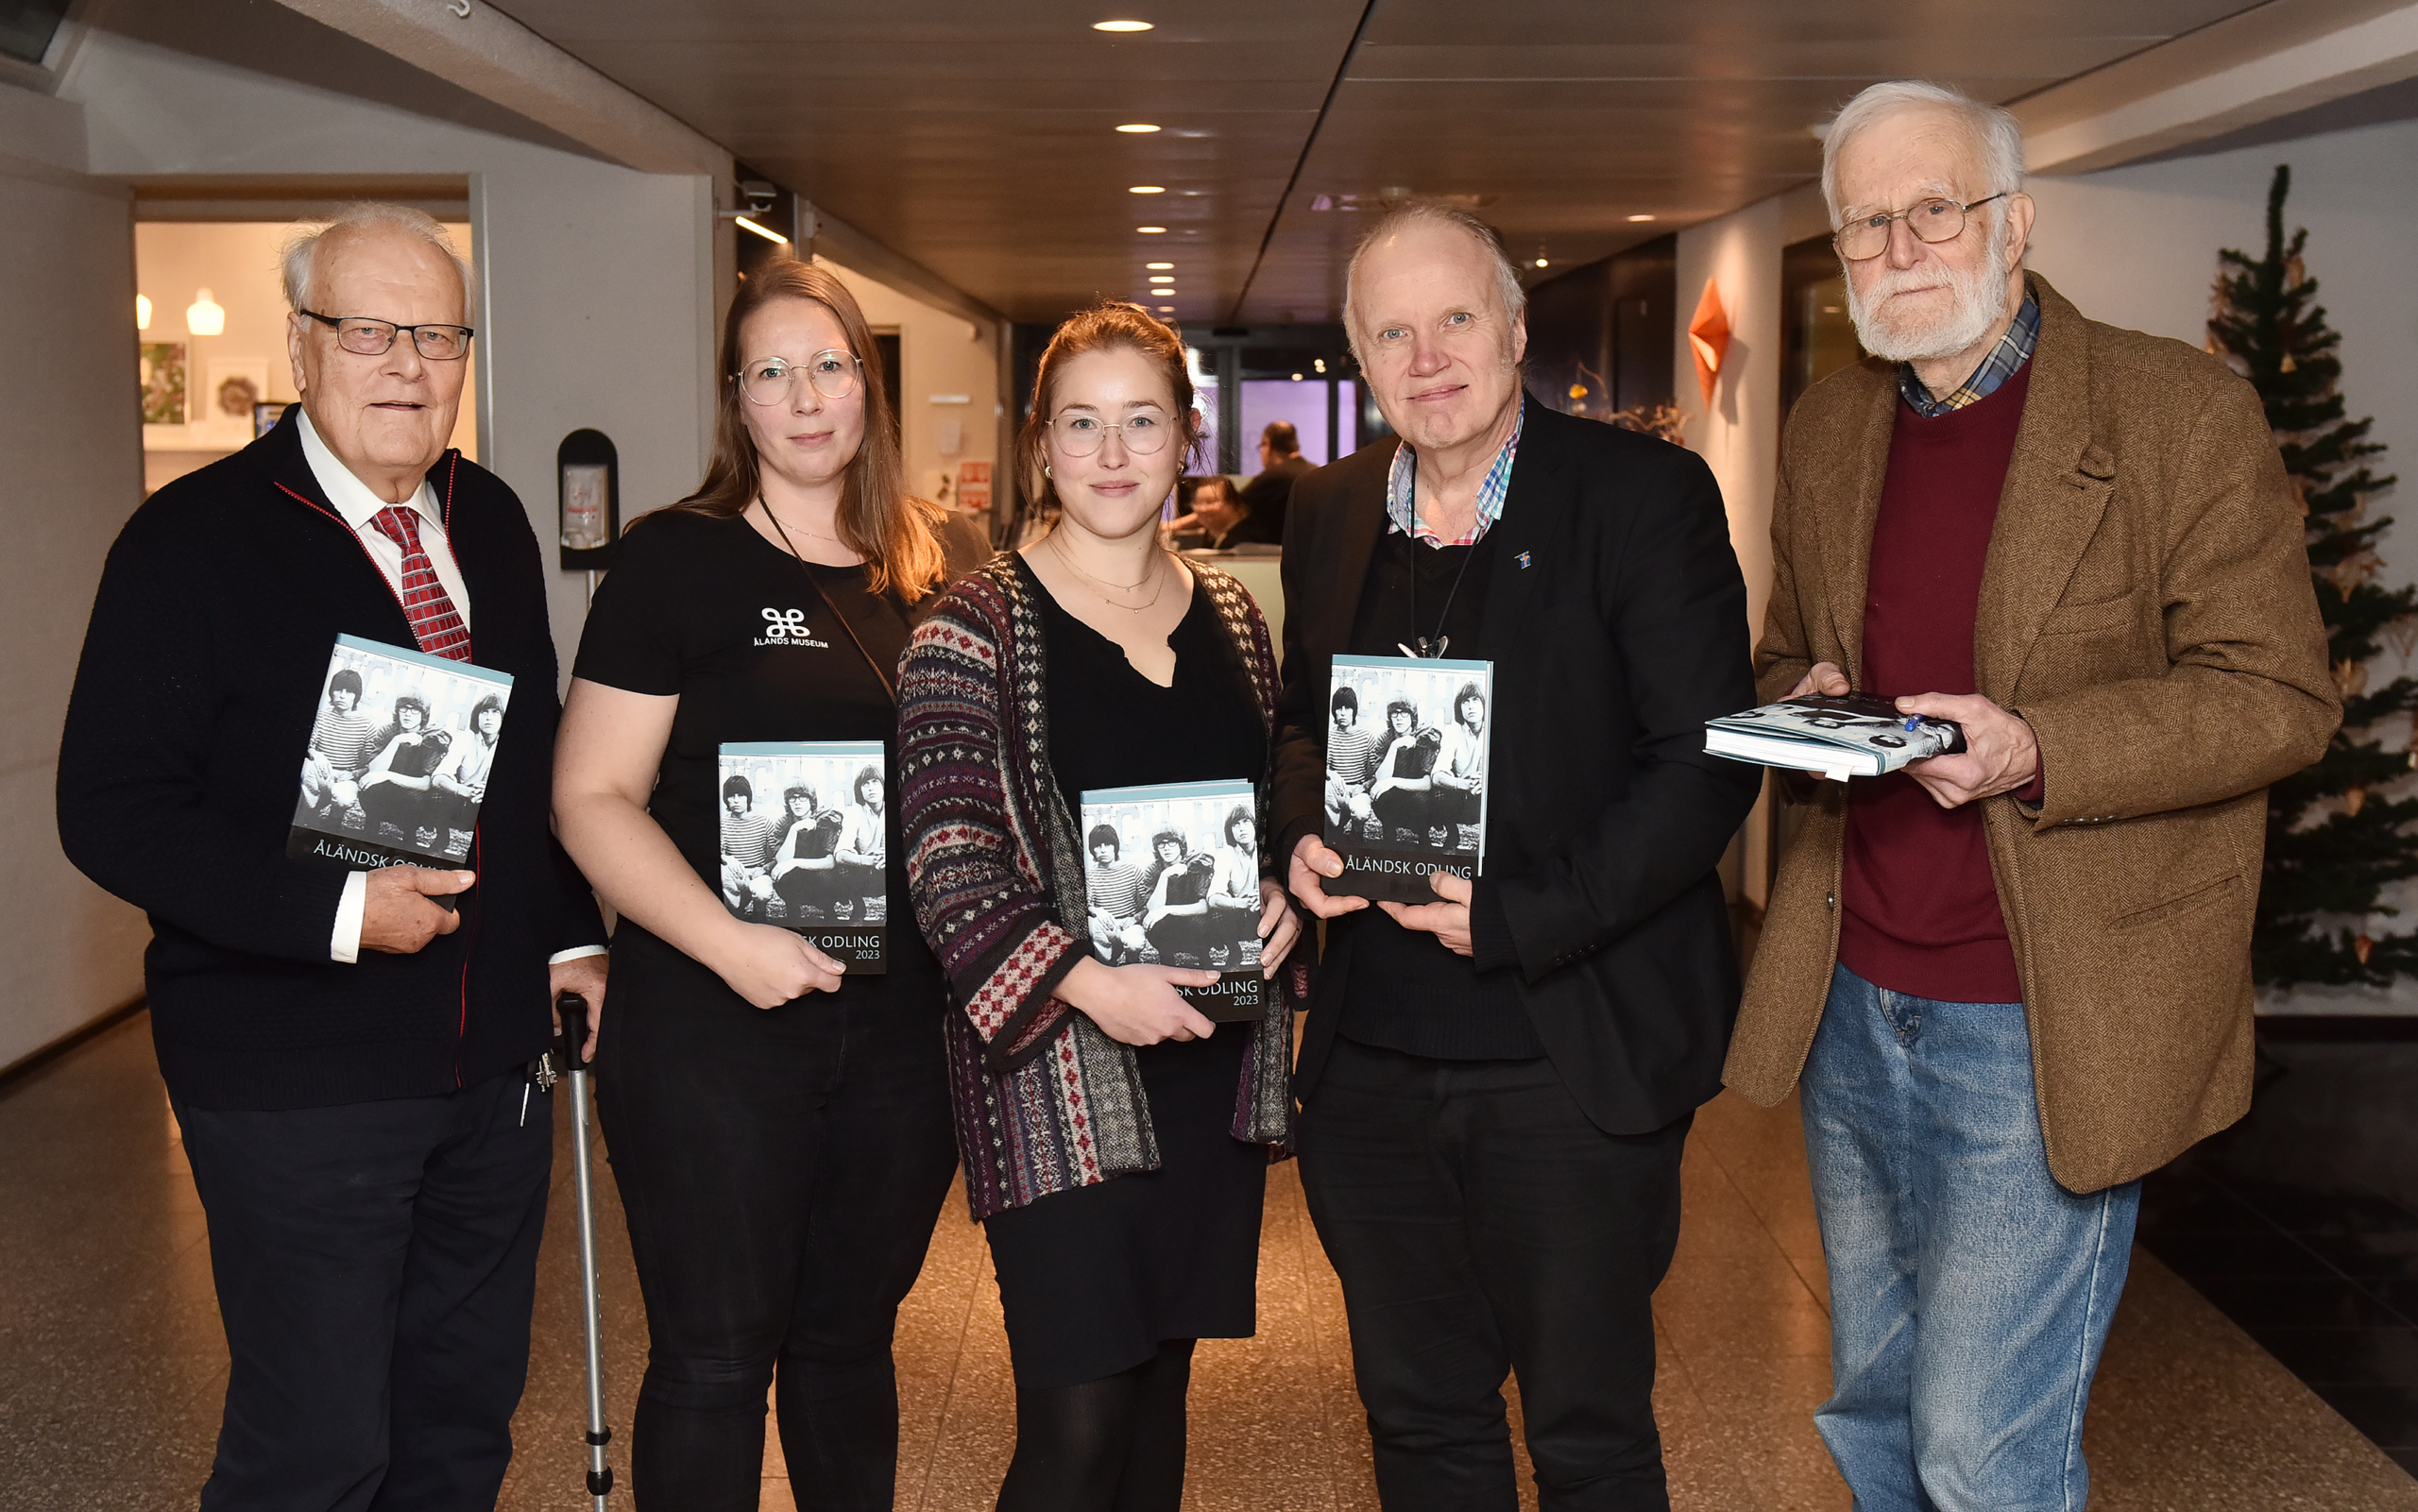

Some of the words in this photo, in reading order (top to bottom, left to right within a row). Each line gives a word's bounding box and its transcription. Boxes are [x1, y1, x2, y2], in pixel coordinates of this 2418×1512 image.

[754, 637, 789, 646] ÅLANDS
[792, 638, 828, 648] MUSEUM
[314, 839, 389, 868] ÅLÄNDSK
[1345, 854, 1411, 875] ÅLÄNDSK
[822, 935, 880, 948] ODLING
[855, 949, 880, 960] 2023
[1198, 979, 1258, 996] ODLING
[1233, 994, 1259, 1006] 2023
